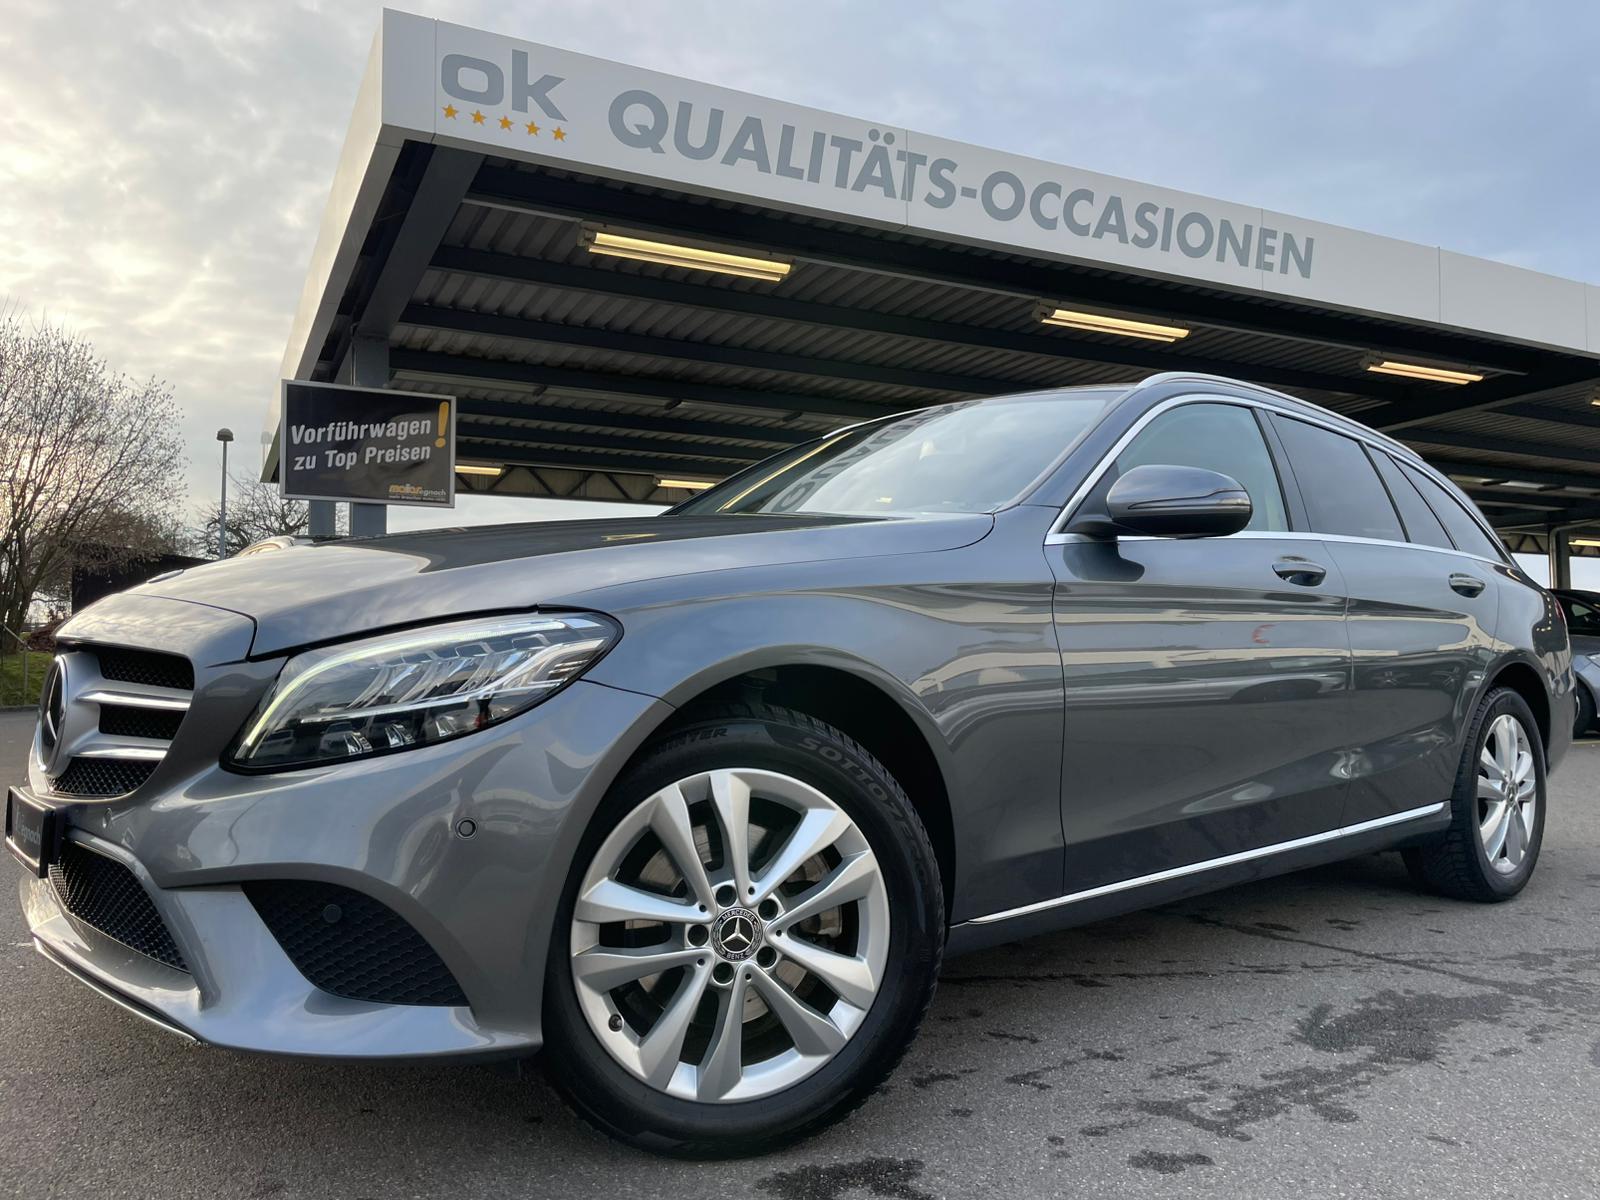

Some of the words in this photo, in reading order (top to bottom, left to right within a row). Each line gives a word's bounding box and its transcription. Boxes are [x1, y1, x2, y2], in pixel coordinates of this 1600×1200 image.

[440, 48, 569, 122] ok
[607, 89, 1315, 279] QUALITÄTS-OCCASIONEN
[291, 419, 431, 445] Vorführwagen
[293, 455, 317, 471] zu
[325, 450, 357, 470] Top
[364, 445, 431, 464] Preisen
[726, 952, 745, 960] BENZ
